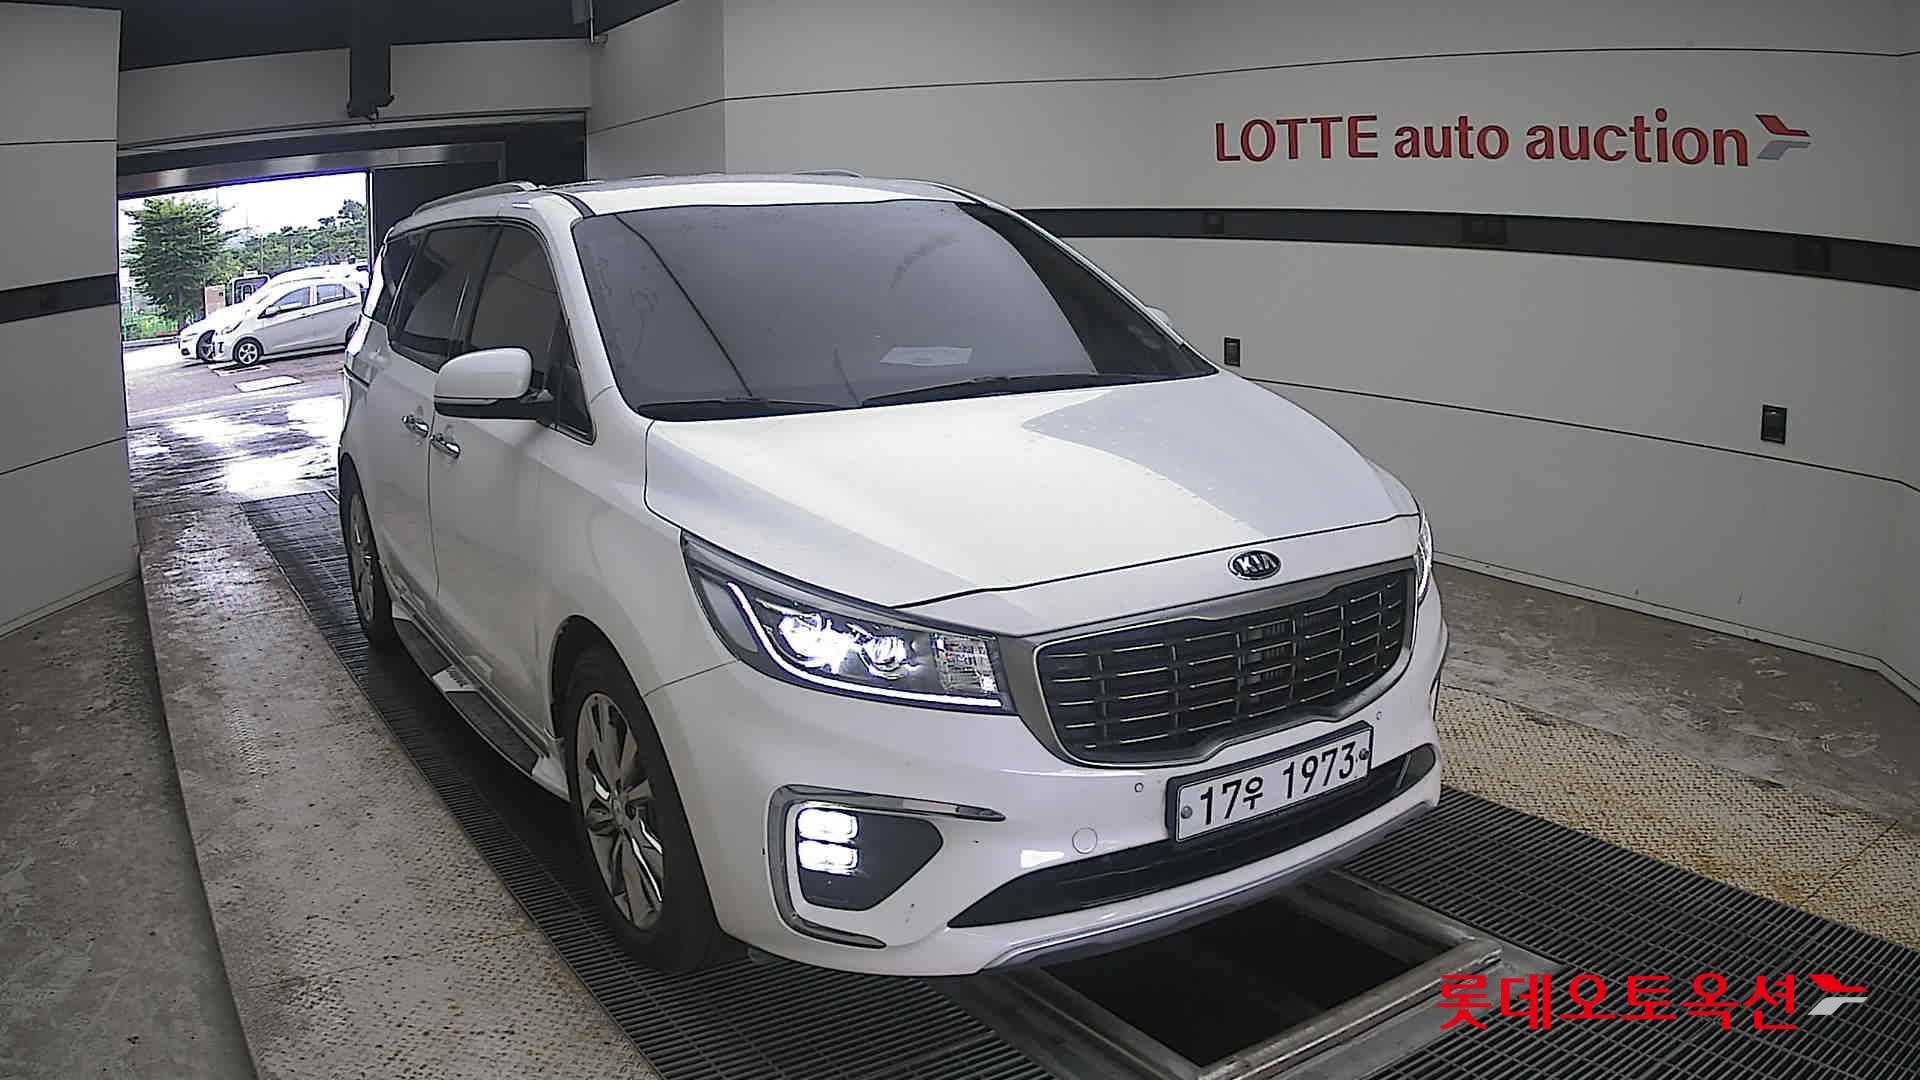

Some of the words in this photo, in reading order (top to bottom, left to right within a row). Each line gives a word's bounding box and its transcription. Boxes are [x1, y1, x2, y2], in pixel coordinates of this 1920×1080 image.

[1215, 115, 1378, 162] LOTTE
[1394, 116, 1510, 160] auto
[1525, 108, 1749, 166] auction
[1234, 551, 1278, 574] KIA
[1200, 776, 1264, 825] 17우
[1282, 741, 1356, 799] 1973
